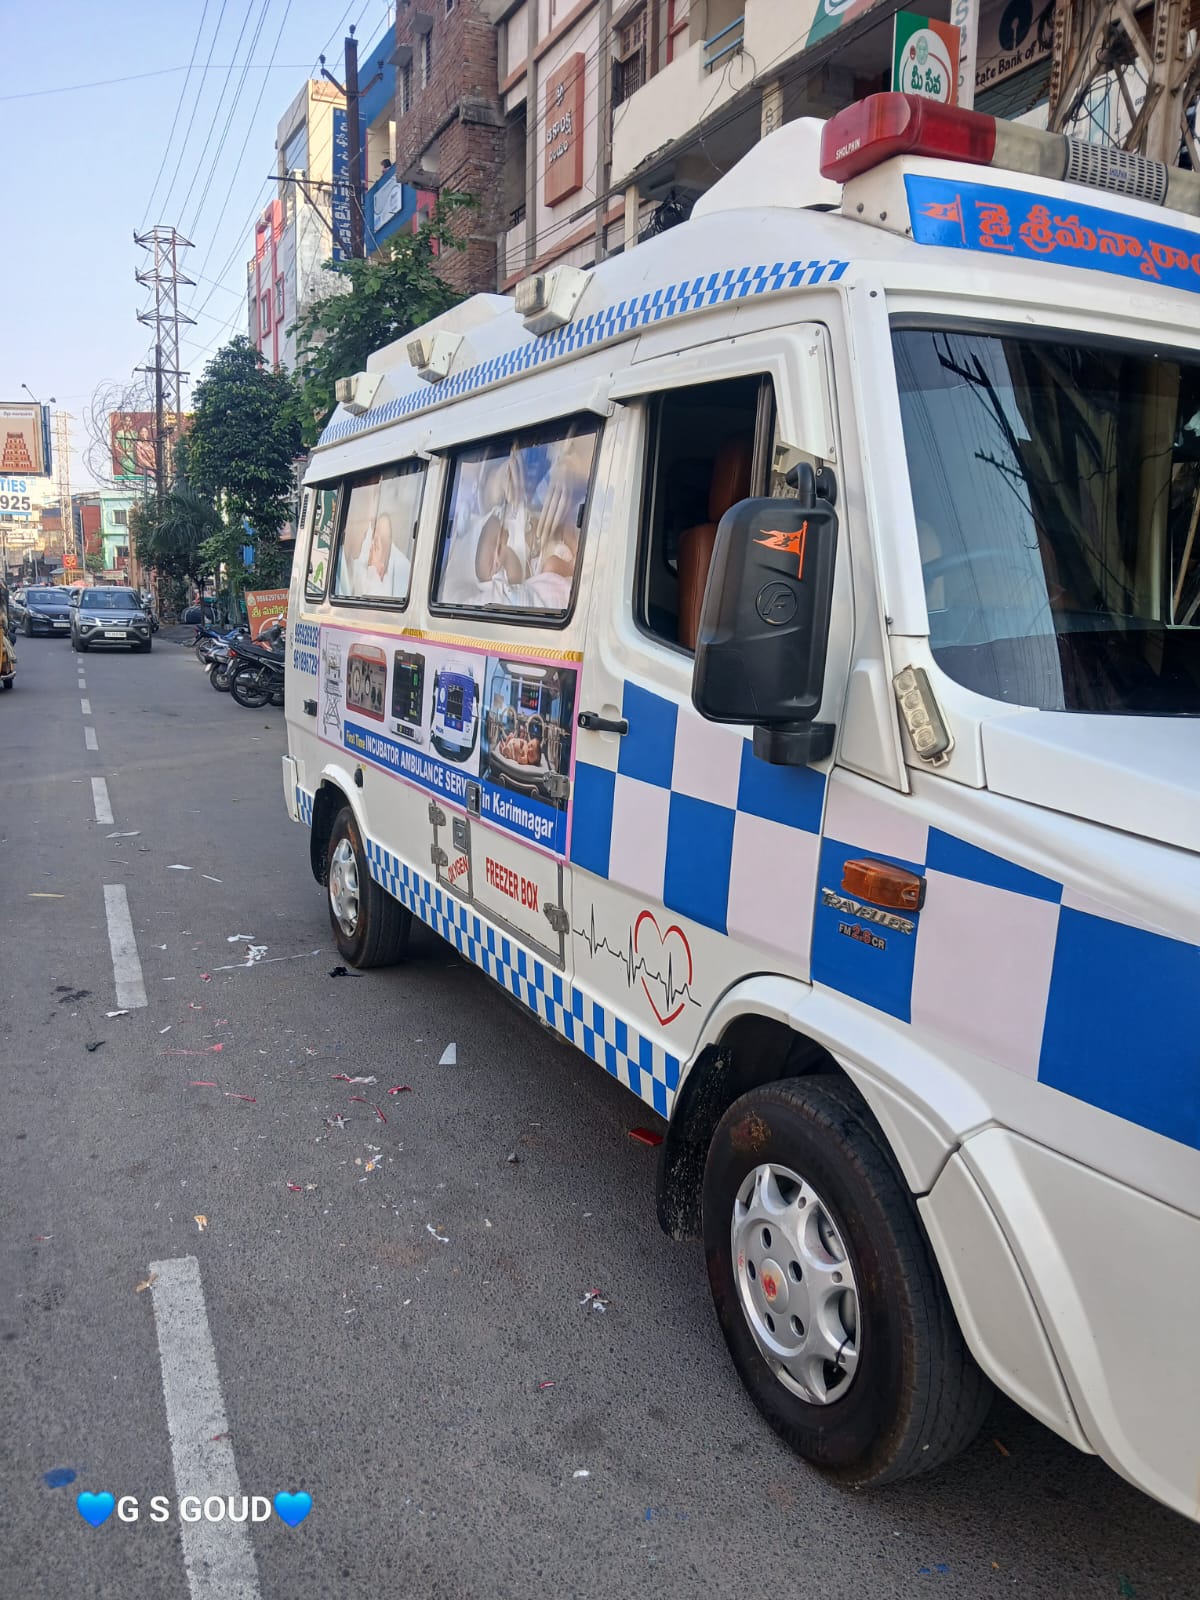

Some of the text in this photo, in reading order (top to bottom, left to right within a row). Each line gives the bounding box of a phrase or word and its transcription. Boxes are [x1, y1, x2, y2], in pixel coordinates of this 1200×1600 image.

[911, 65, 941, 95] మీ సేవ
[975, 69, 996, 86] tate
[999, 53, 1023, 75] Bank
[1025, 40, 1038, 59] of
[975, 201, 1014, 252] జై
[366, 735, 400, 766] INCUBATOR
[400, 750, 445, 788] AMBULANCE
[445, 770, 468, 799] SERV
[482, 787, 491, 811] in
[493, 791, 555, 840] Karimnagar
[447, 854, 469, 884] OXYGEN
[485, 856, 539, 913] FREEZER BOX
[822, 886, 916, 936] TRAVELLER
